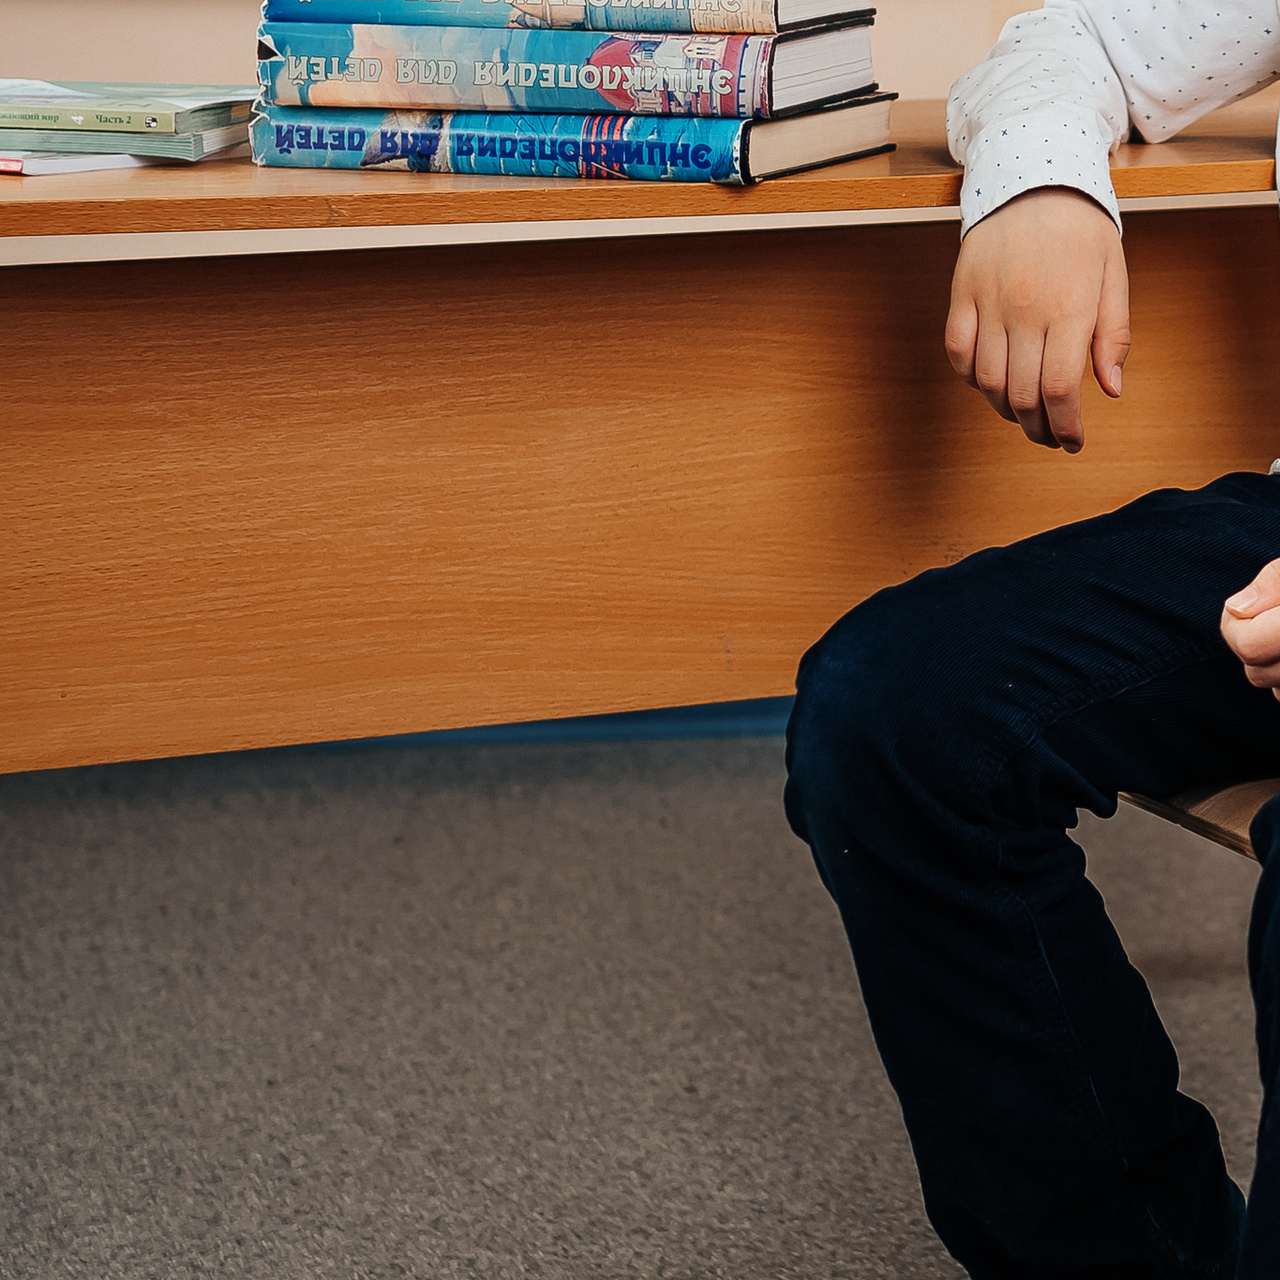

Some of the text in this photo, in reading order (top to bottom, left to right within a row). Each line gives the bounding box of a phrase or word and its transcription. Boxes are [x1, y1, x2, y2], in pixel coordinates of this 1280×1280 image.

[286, 55, 735, 94] ЭНЦИКЛОПЕДИЯ ДЛЯ ДЕТЕЙ
[274, 124, 714, 170] ЭНЦИКЛОПЕДИЯ ДЛЯ ДЕТЕЙ
